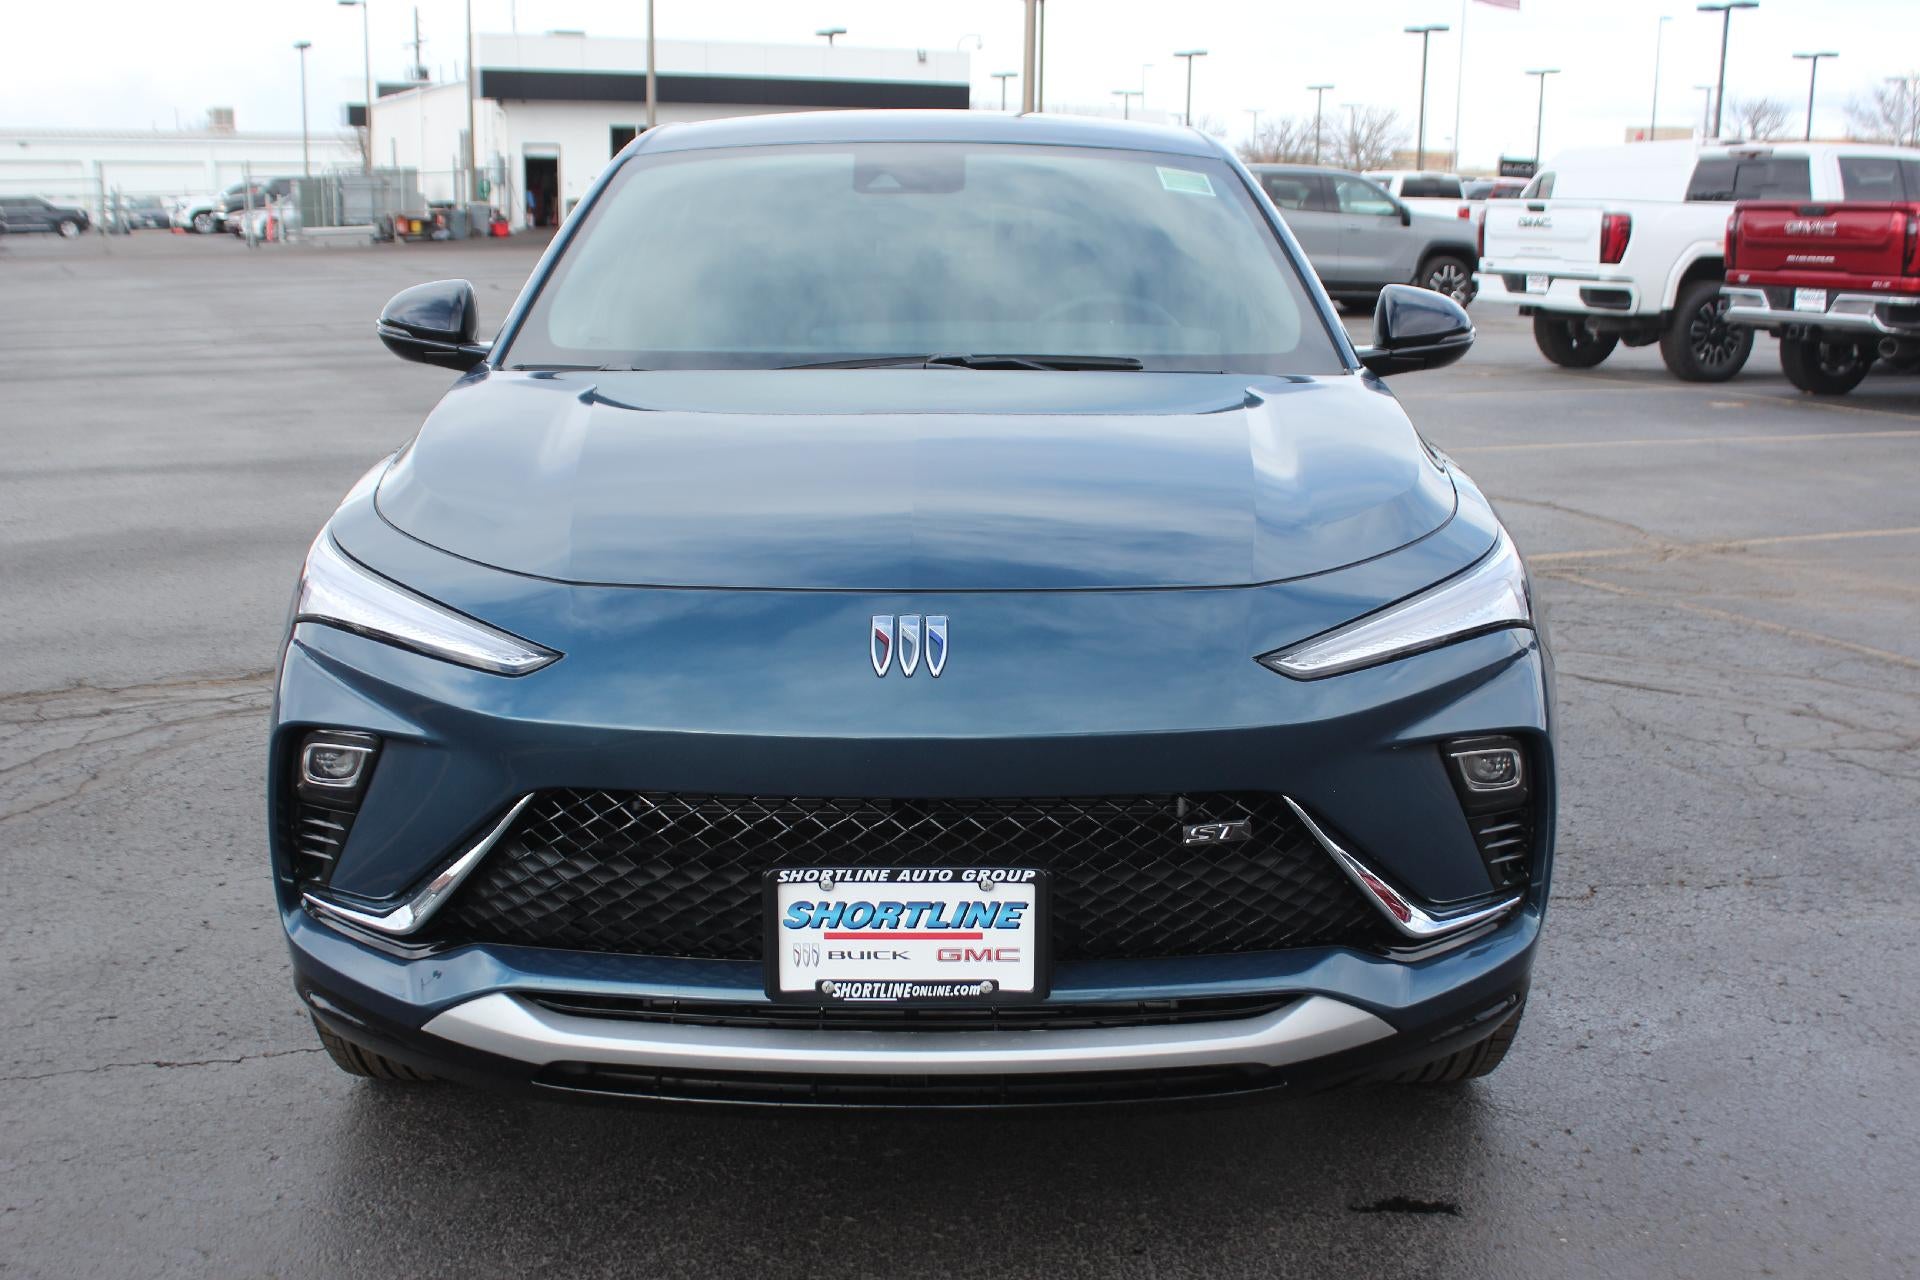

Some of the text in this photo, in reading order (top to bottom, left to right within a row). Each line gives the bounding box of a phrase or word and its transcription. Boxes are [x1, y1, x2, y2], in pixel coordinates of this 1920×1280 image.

[1518, 217, 1552, 228] GMC
[1784, 221, 1837, 235] GMC
[1786, 255, 1835, 263] SIERRA
[1185, 820, 1246, 844] ST
[777, 870, 1036, 882] SHORTLINE AUTO GROUP
[783, 901, 1029, 930] SHORTLINE
[828, 948, 1021, 963] BUICK GMC
